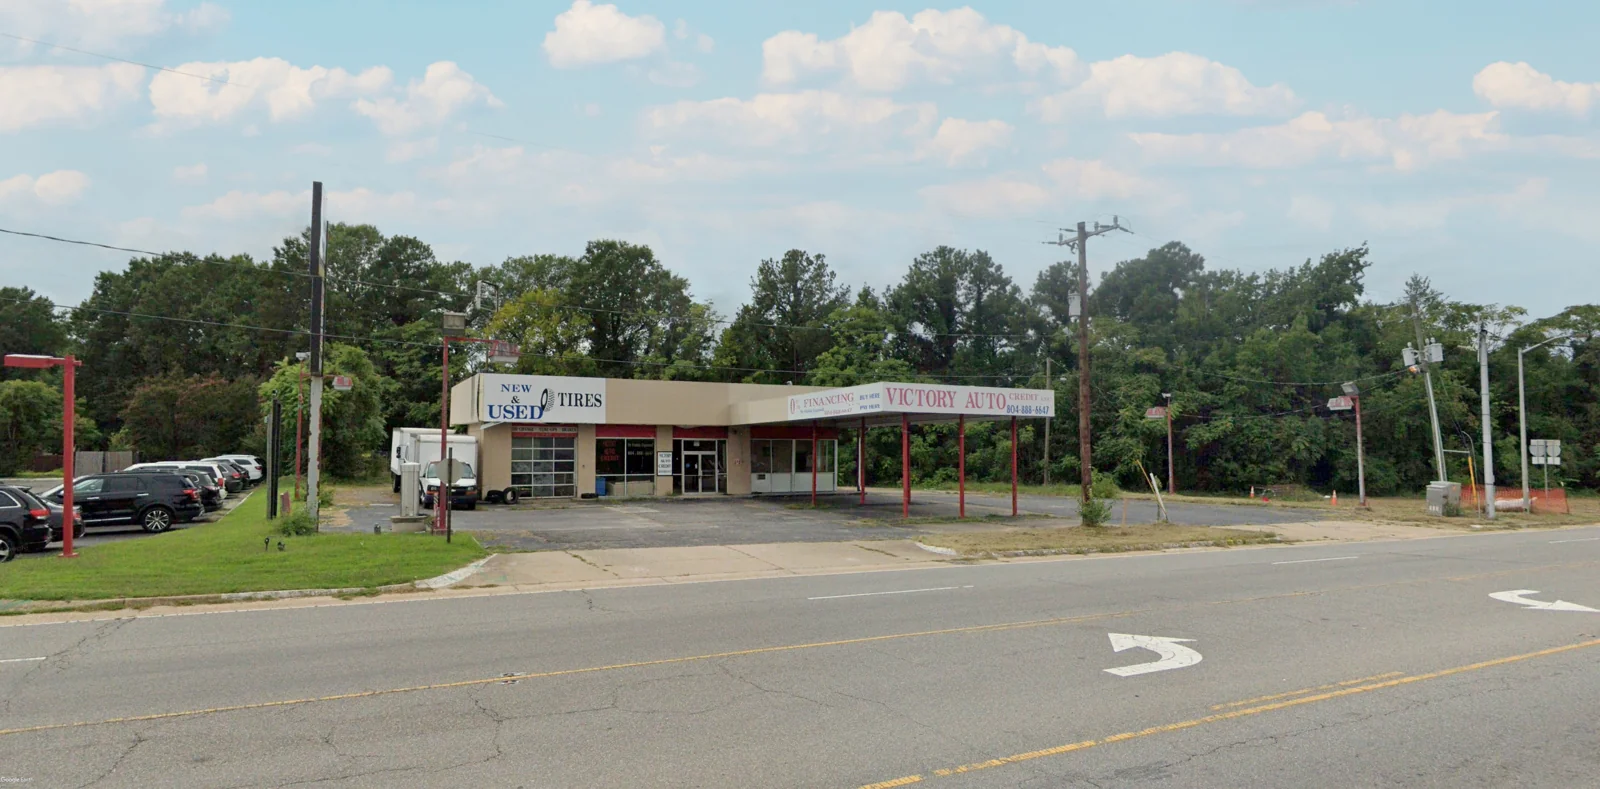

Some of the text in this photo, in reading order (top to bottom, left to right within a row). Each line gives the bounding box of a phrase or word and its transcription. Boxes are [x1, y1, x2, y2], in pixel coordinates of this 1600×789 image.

[501, 384, 532, 393] NEW
[511, 395, 520, 404] &
[558, 392, 602, 408] TIRES
[803, 392, 854, 408] FINANCING
[886, 387, 1039, 410] VICTORY AUTO CREDIT
[487, 404, 544, 420] USED
[1006, 404, 1050, 415] 804-888-6647
